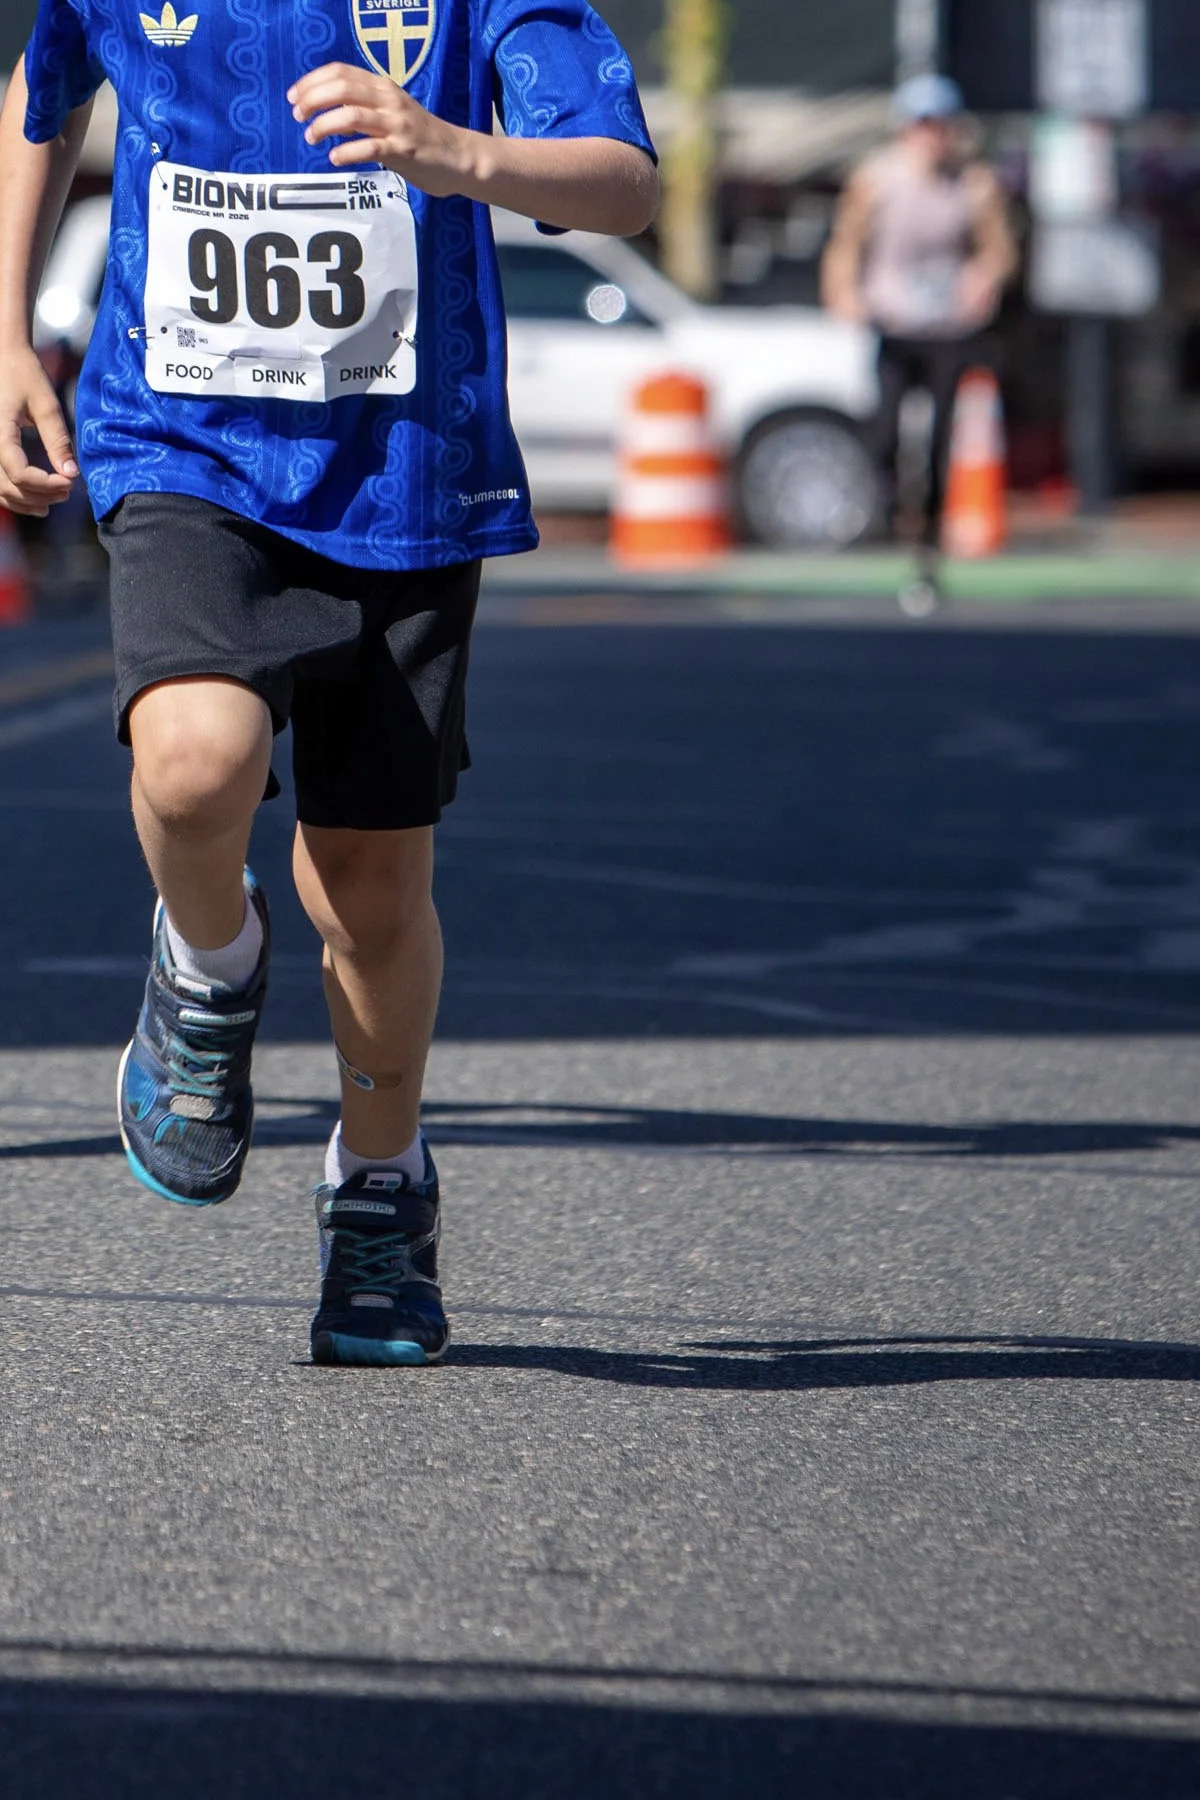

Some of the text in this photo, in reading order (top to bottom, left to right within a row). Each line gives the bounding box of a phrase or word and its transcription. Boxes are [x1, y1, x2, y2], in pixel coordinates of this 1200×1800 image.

[173, 173, 347, 211] BIONIC
[228, 213, 250, 221] 2026
[188, 228, 365, 329] 963
[166, 364, 397, 386] FOOD DRINK DRINK
